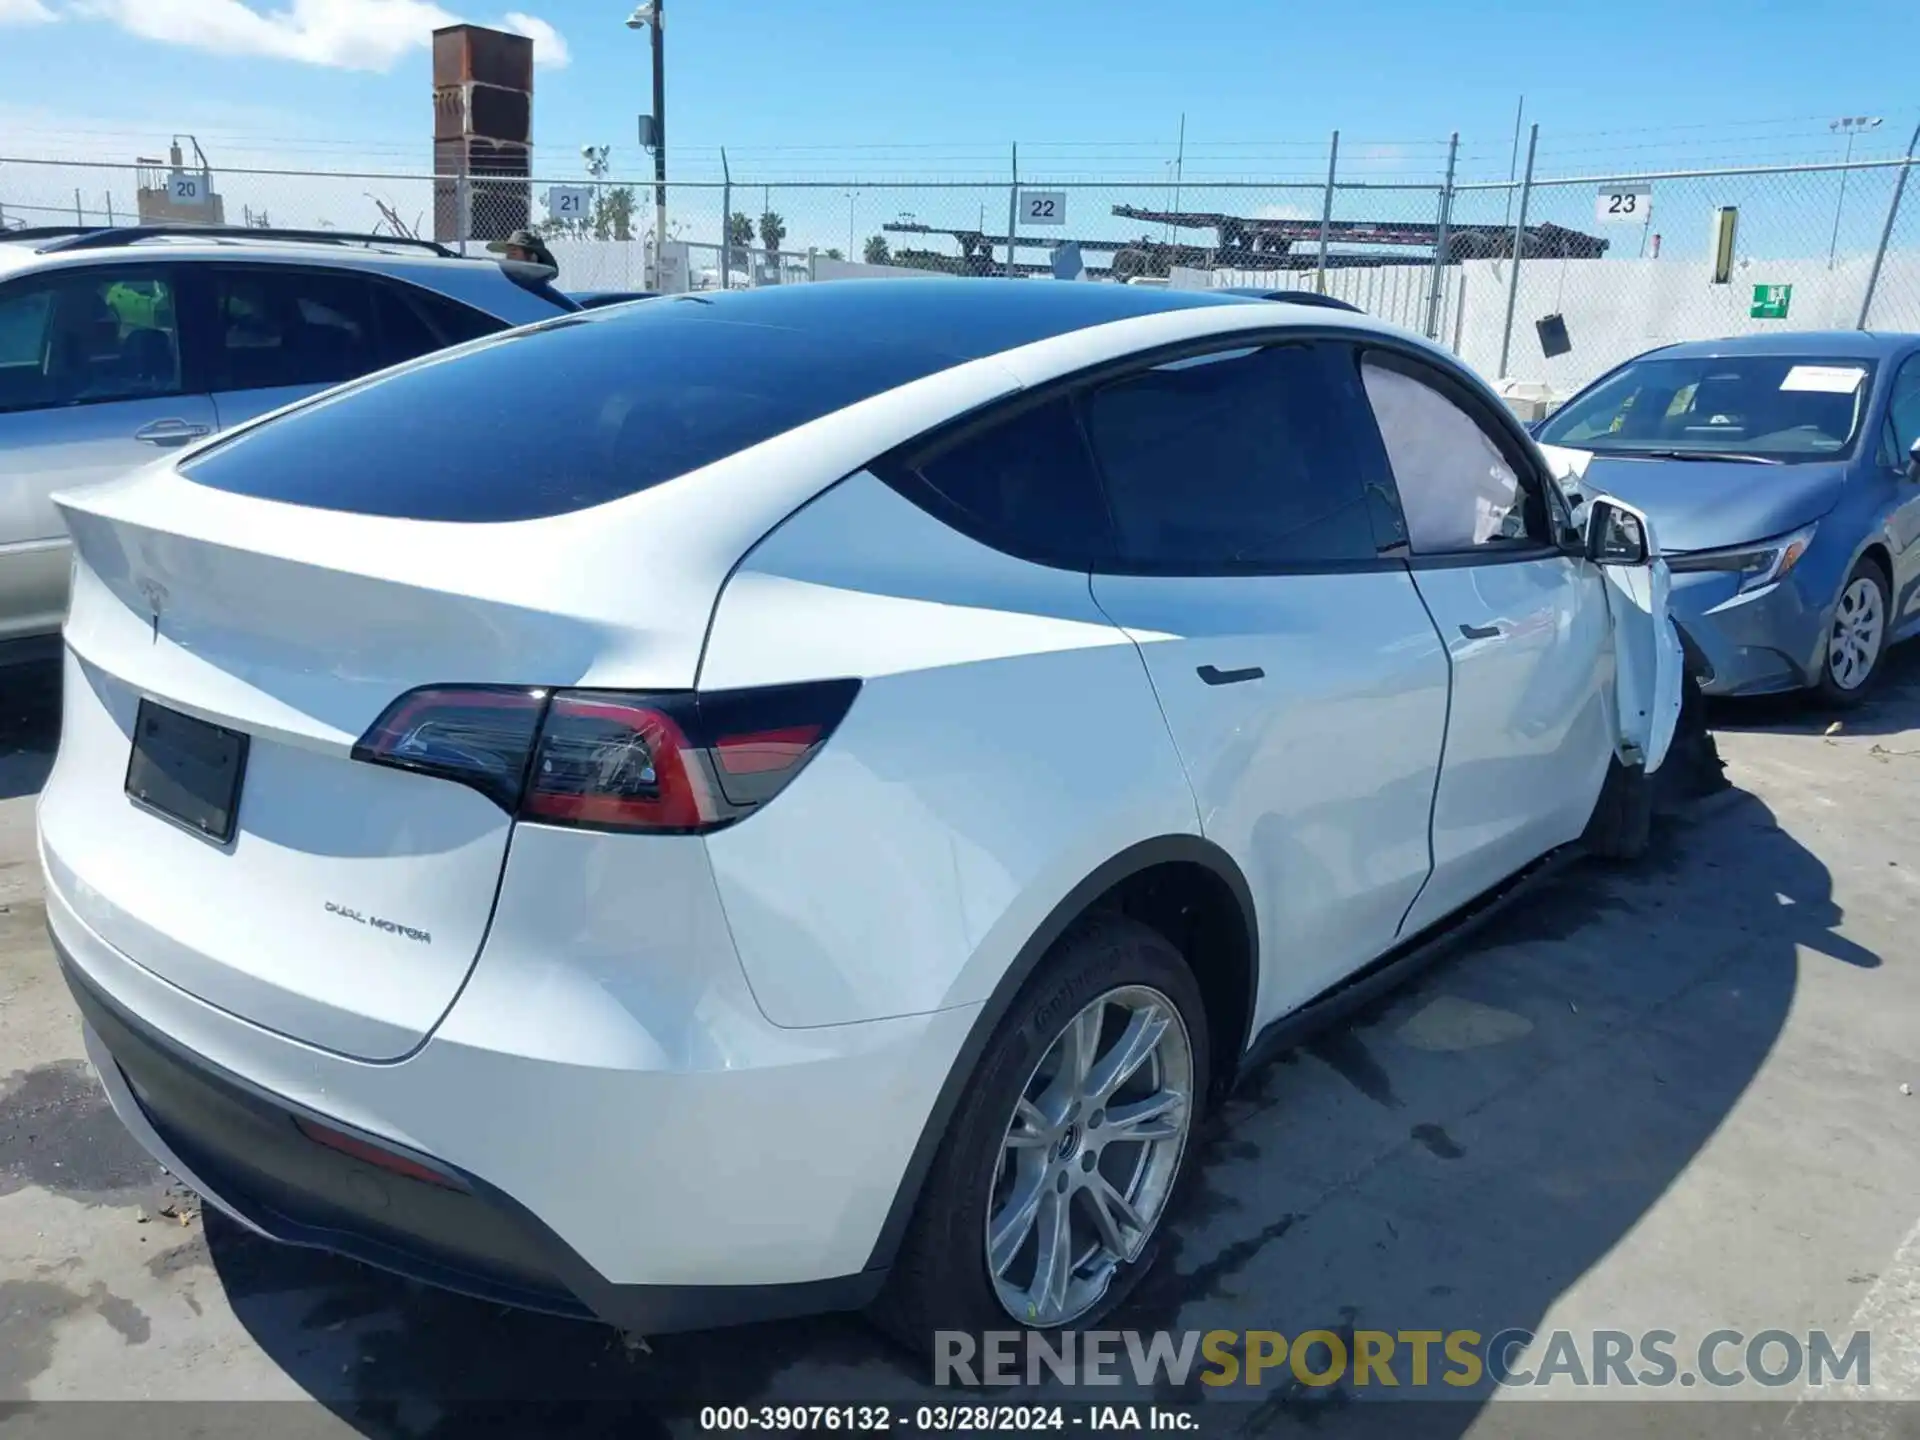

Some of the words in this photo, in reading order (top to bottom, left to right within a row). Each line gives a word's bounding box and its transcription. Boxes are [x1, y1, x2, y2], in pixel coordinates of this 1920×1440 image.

[176, 181, 196, 197] 20
[560, 195, 579, 211] 21
[1030, 199, 1055, 217] 22
[1608, 193, 1637, 214] 23
[324, 900, 367, 924] DUAL
[369, 916, 431, 944] MOTOR
